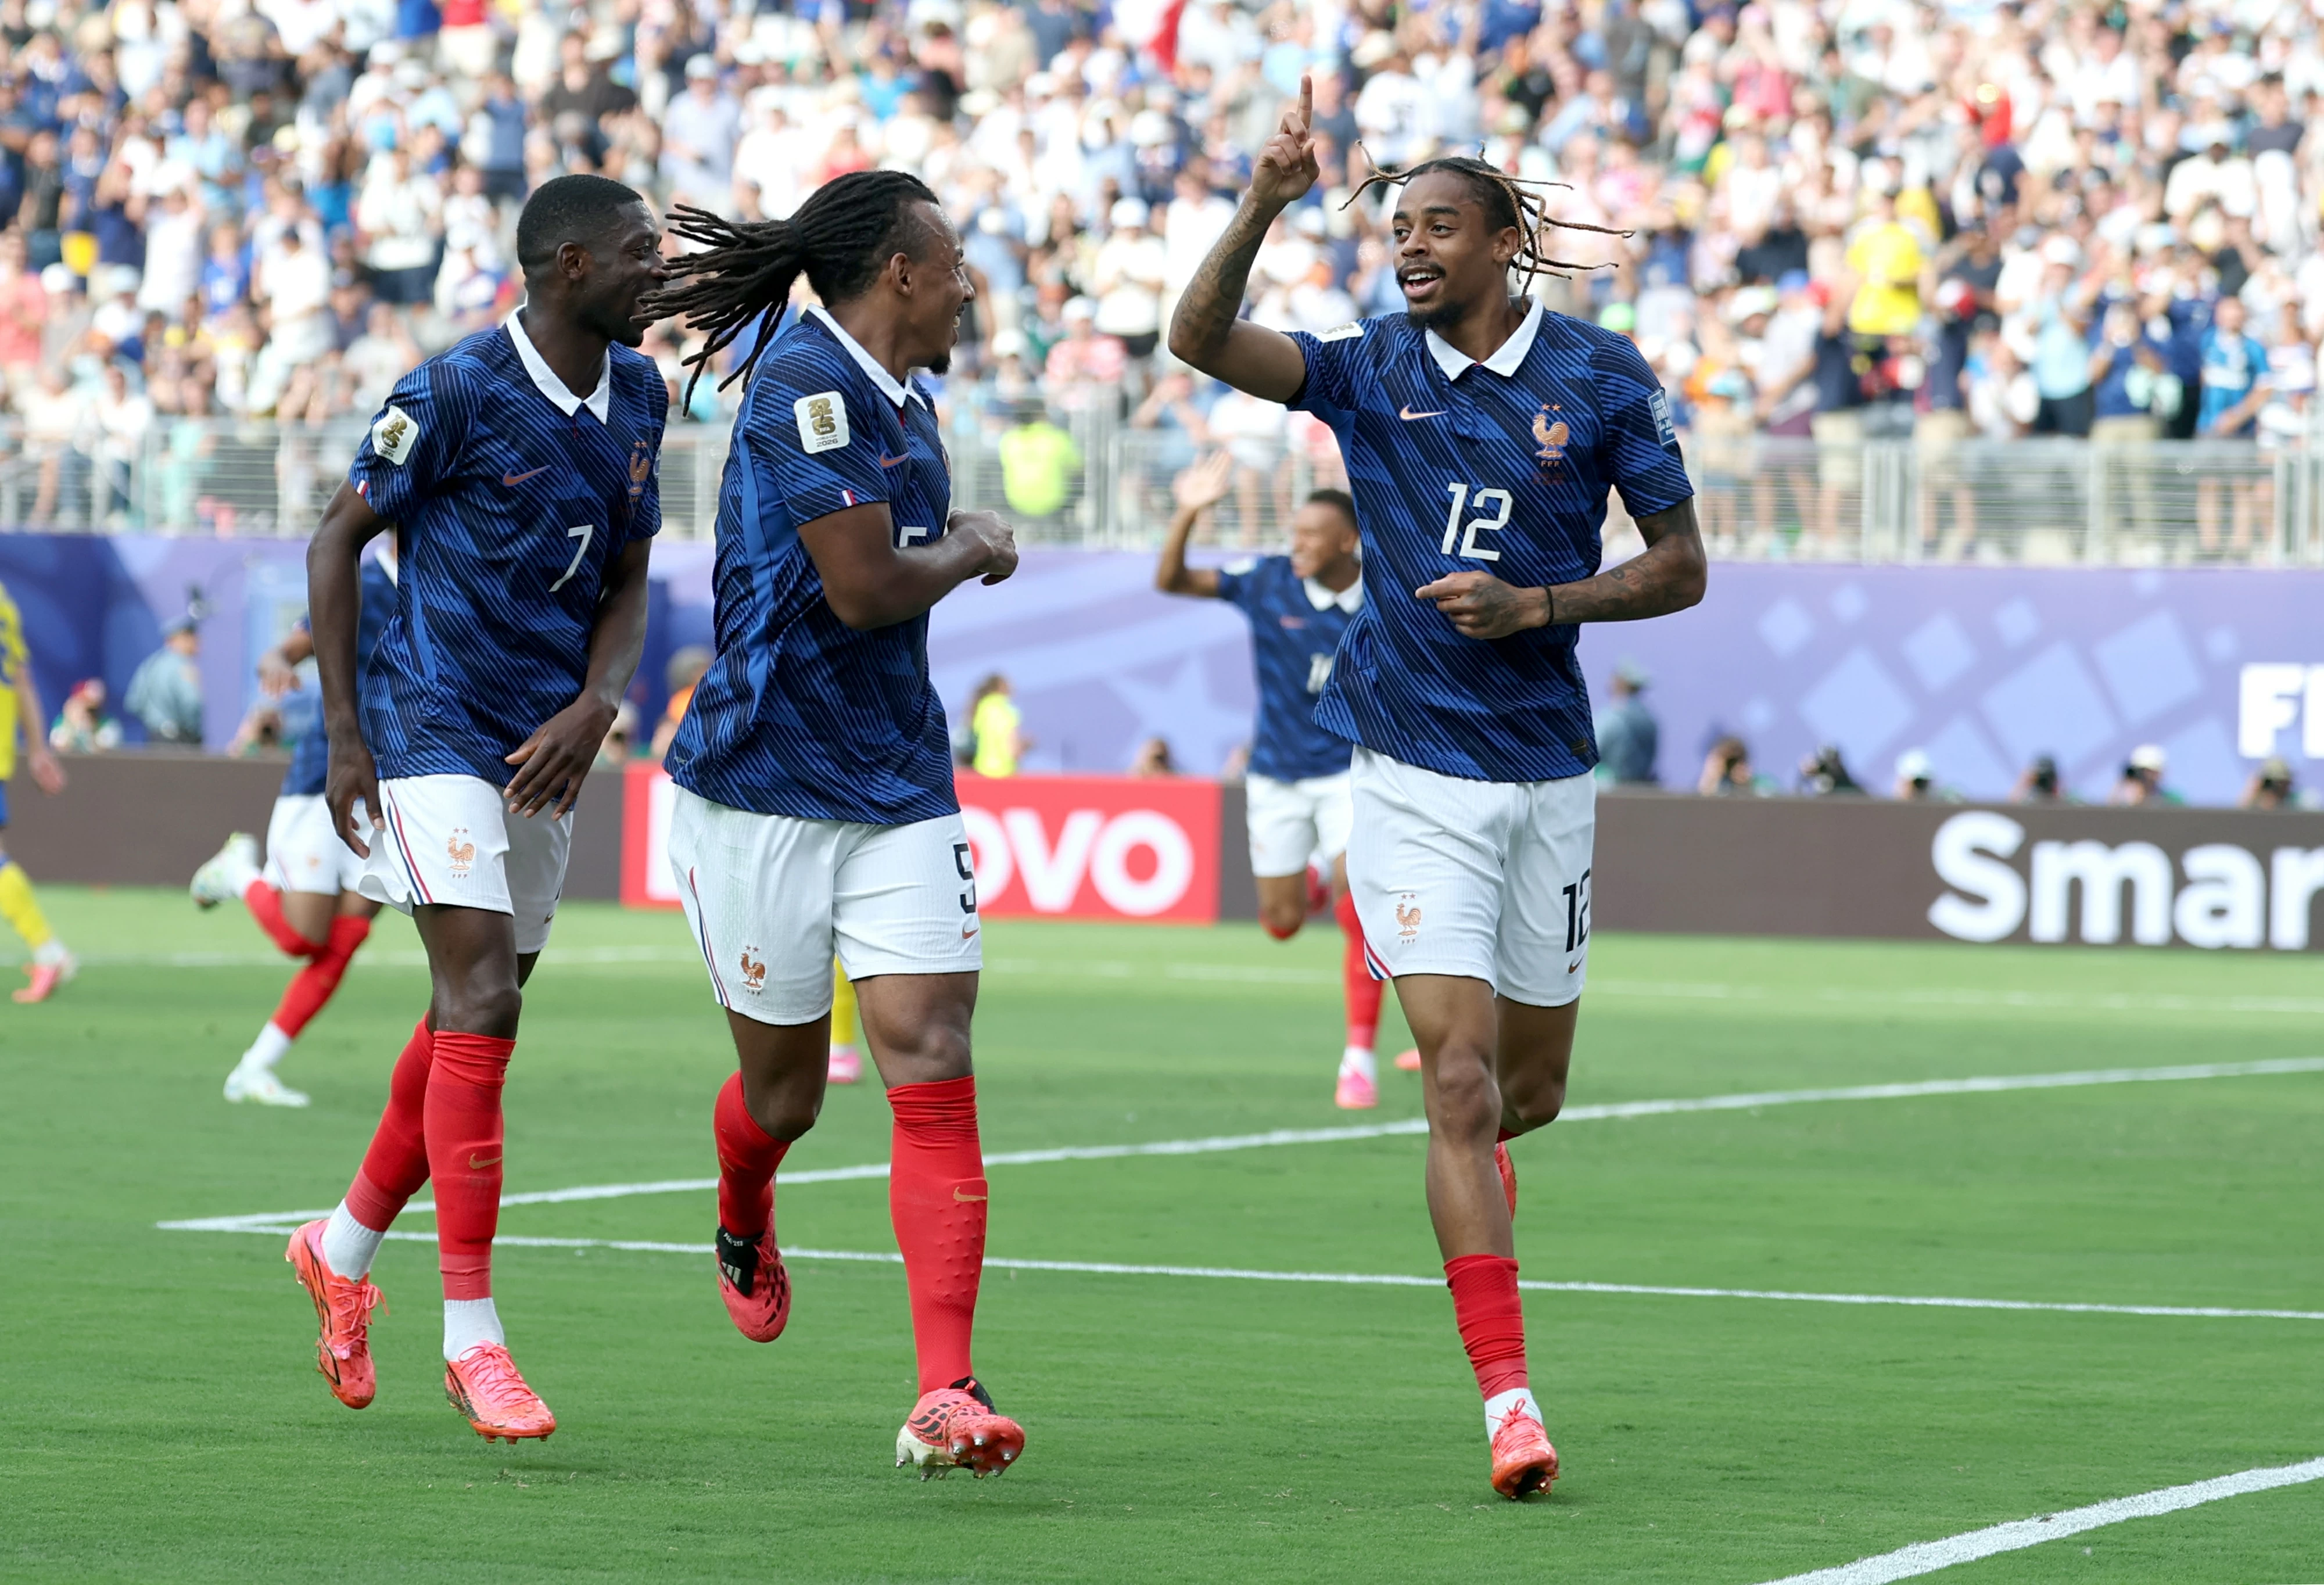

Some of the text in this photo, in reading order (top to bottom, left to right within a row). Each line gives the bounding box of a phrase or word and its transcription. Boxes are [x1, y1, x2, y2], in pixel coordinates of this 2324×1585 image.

[816, 438, 838, 447] 2026
[548, 524, 593, 593] 7
[1441, 482, 1513, 562] 12
[953, 842, 977, 914] 5
[1562, 867, 1590, 953] 12
[1927, 811, 2324, 951] Smar
